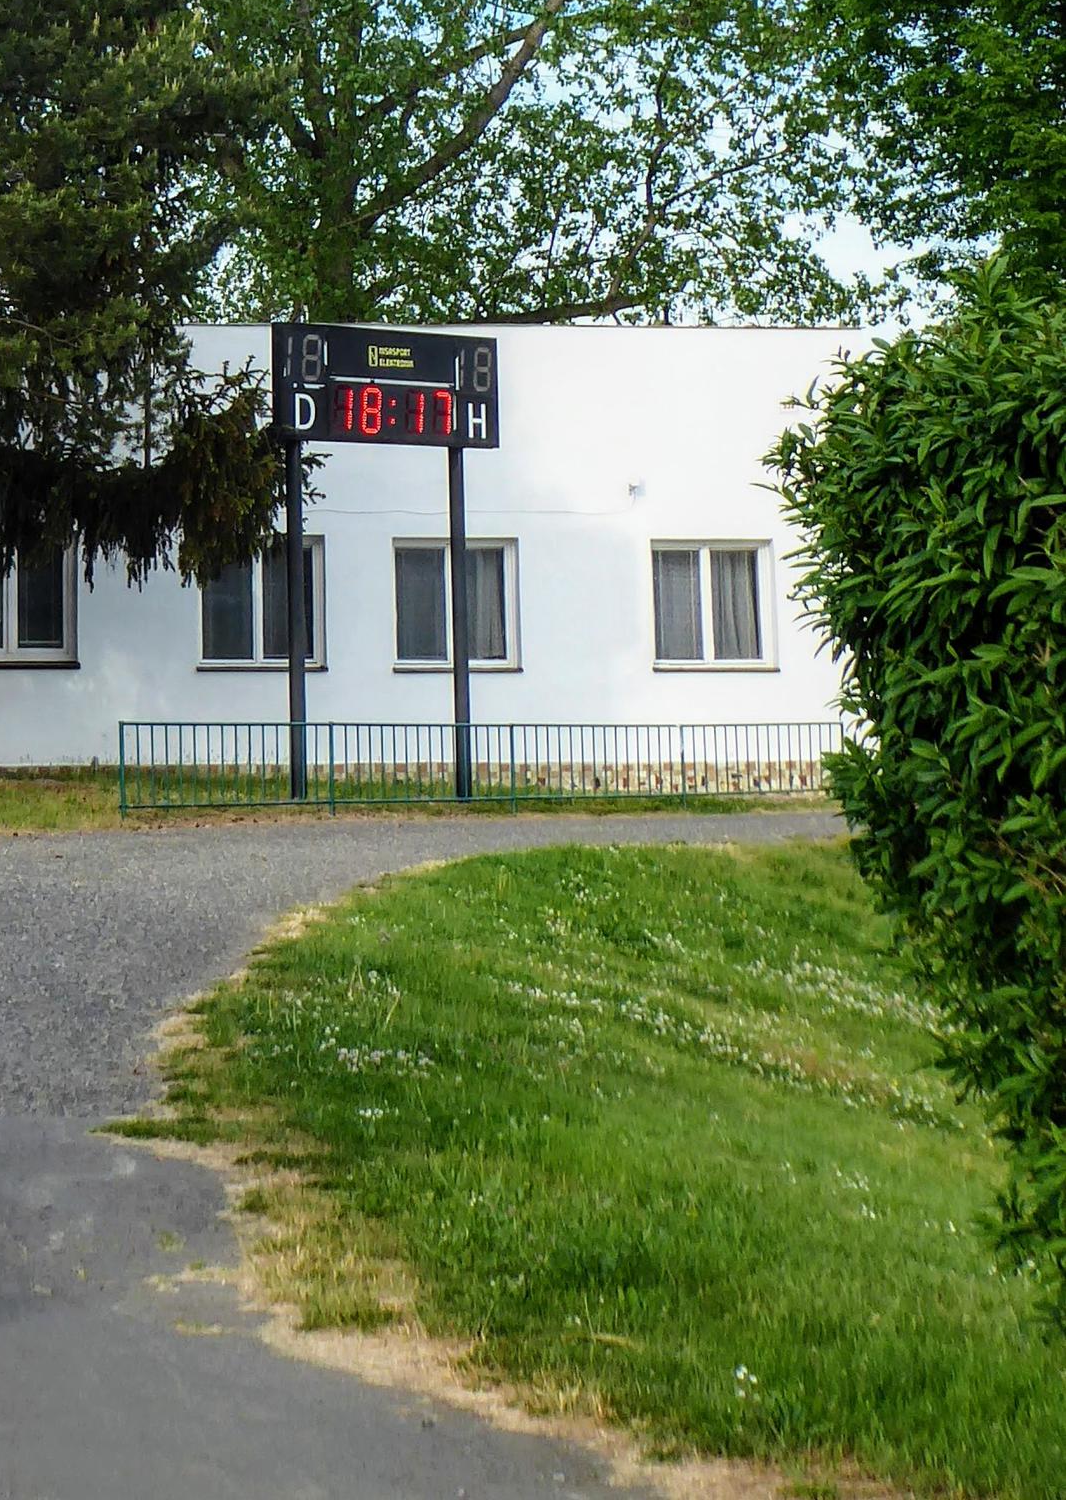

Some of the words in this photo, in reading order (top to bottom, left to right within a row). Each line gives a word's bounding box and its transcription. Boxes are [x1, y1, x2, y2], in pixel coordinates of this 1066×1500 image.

[295, 393, 316, 430] D
[343, 386, 452, 435] 18:17
[467, 402, 487, 439] H
